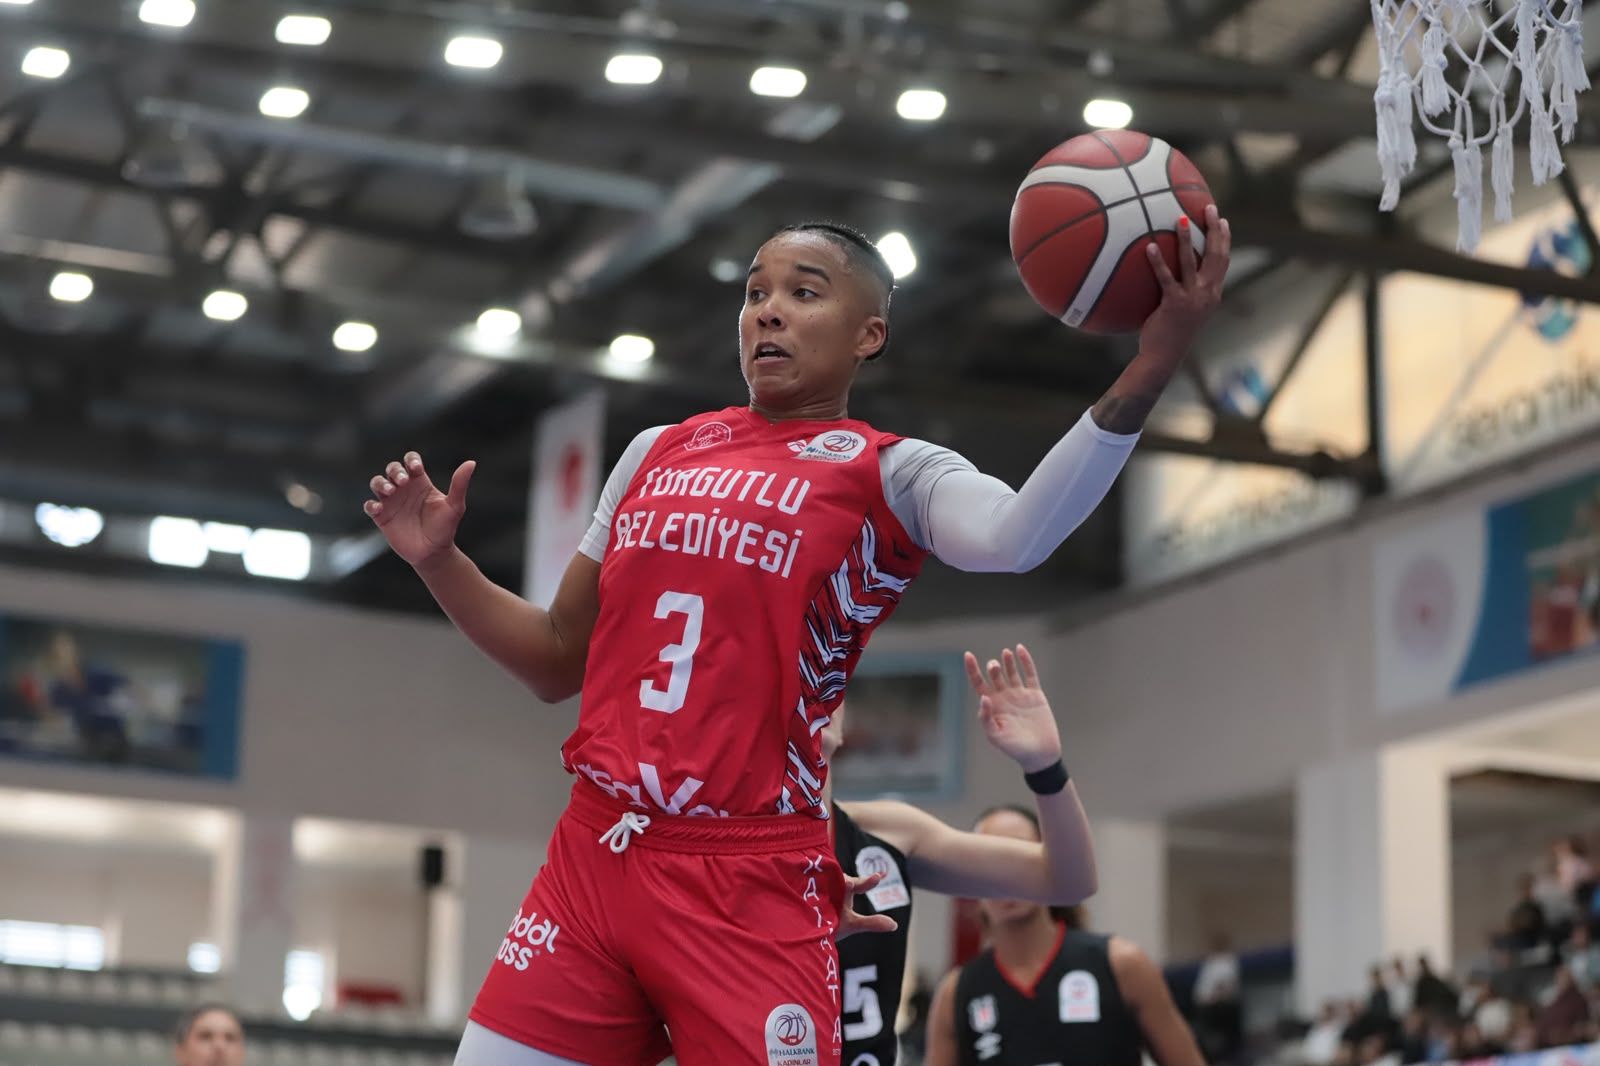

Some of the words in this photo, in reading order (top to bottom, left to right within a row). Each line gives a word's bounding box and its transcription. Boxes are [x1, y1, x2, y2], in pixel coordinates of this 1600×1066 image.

[639, 466, 811, 516] TURGUTLU
[613, 508, 804, 579] BELEDİYESİ
[639, 590, 704, 714] 3
[779, 1047, 816, 1057] HALKBANK
